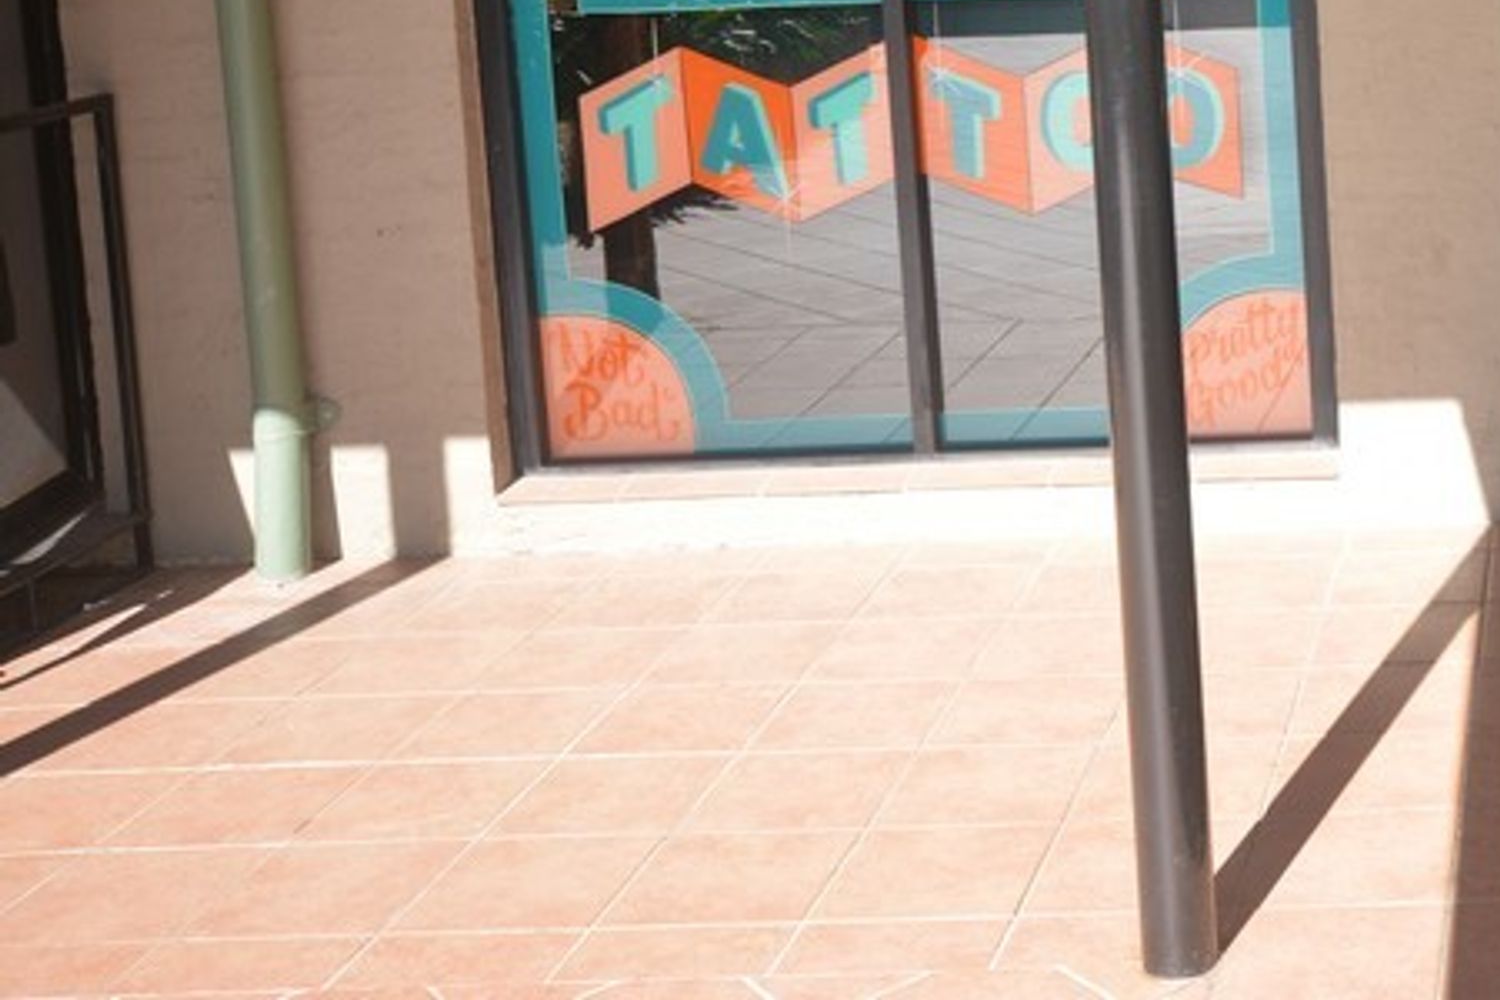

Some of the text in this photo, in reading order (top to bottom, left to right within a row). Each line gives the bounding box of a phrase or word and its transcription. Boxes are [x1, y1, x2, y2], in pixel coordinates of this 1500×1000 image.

[597, 68, 1225, 201] TATTOO
[547, 322, 650, 387] Not
[562, 379, 682, 444] Bad
